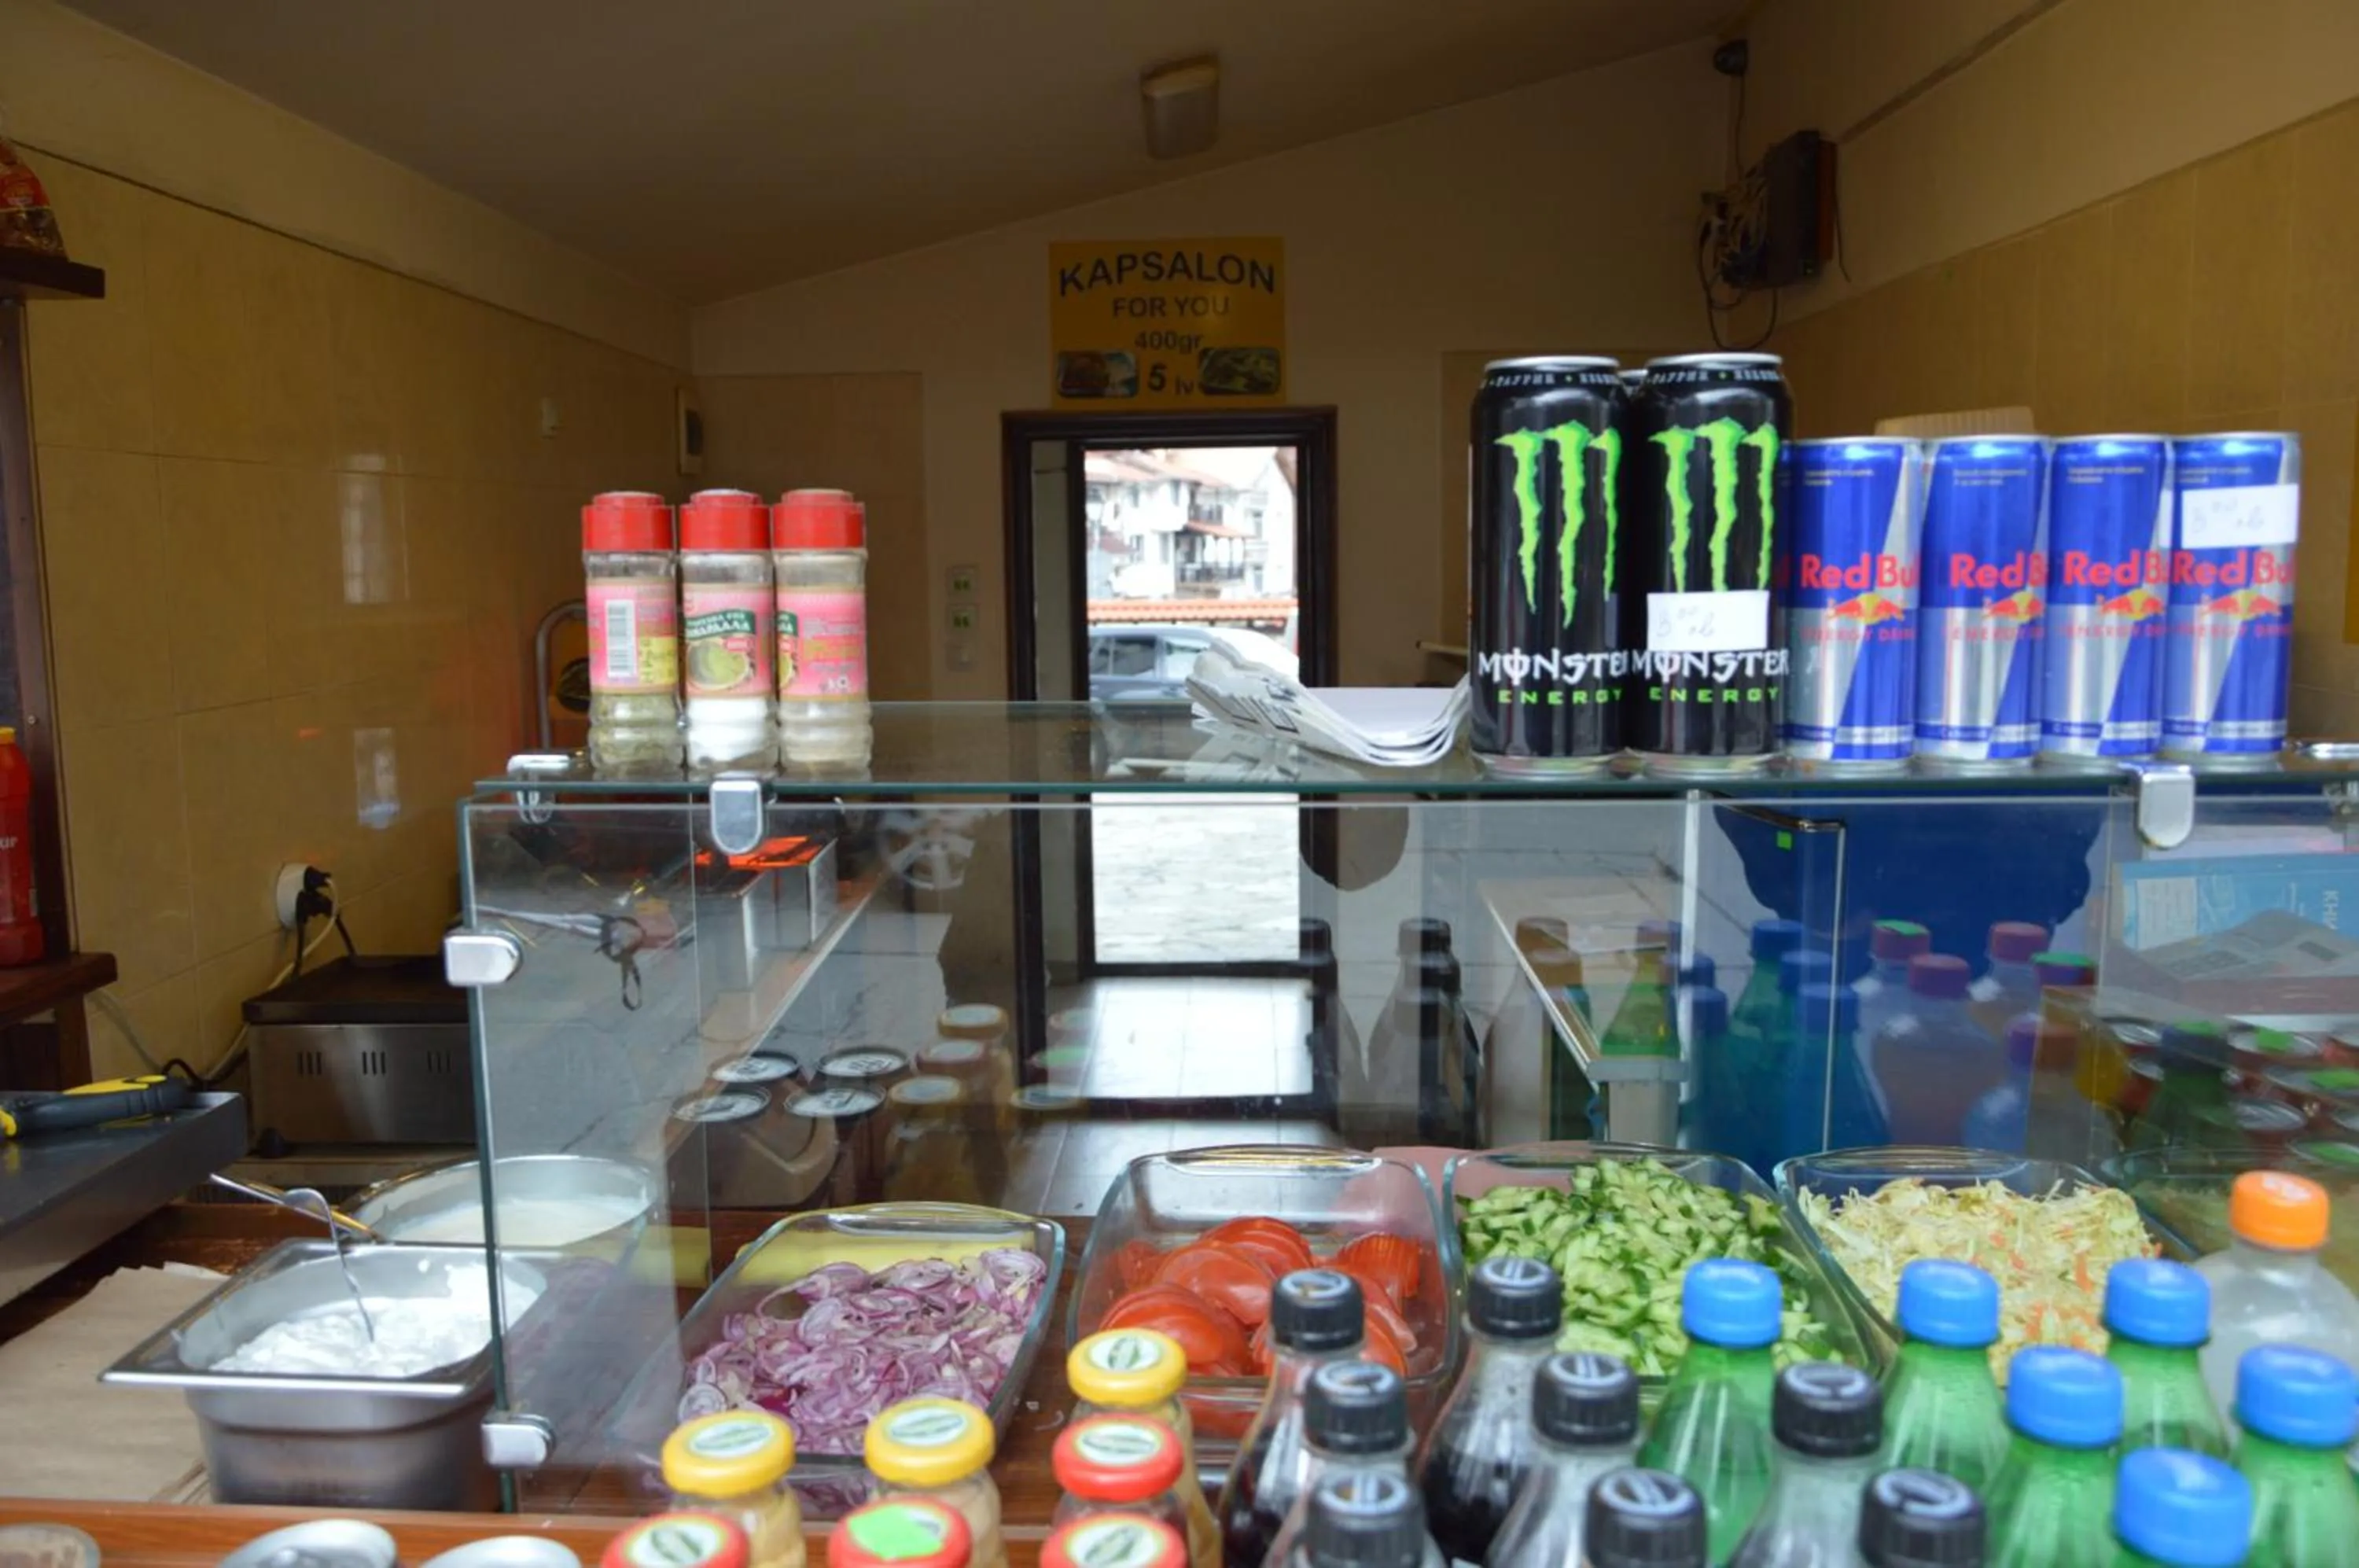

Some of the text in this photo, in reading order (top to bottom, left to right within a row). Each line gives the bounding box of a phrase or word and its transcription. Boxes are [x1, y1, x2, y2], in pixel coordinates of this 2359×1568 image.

[1058, 250, 1275, 297] KAPSALON
[1112, 295, 1230, 318] FOR YOU
[1135, 330, 1204, 354] 400gr
[1146, 363, 1168, 392] 5
[1800, 551, 1872, 590] Red
[1949, 551, 2026, 589] Red
[2063, 549, 2141, 587] Red
[2173, 550, 2247, 585] Red
[1632, 649, 1790, 683] MONSTER
[1497, 688, 1622, 705] ENERGY
[1648, 686, 1779, 703] ENERGY
